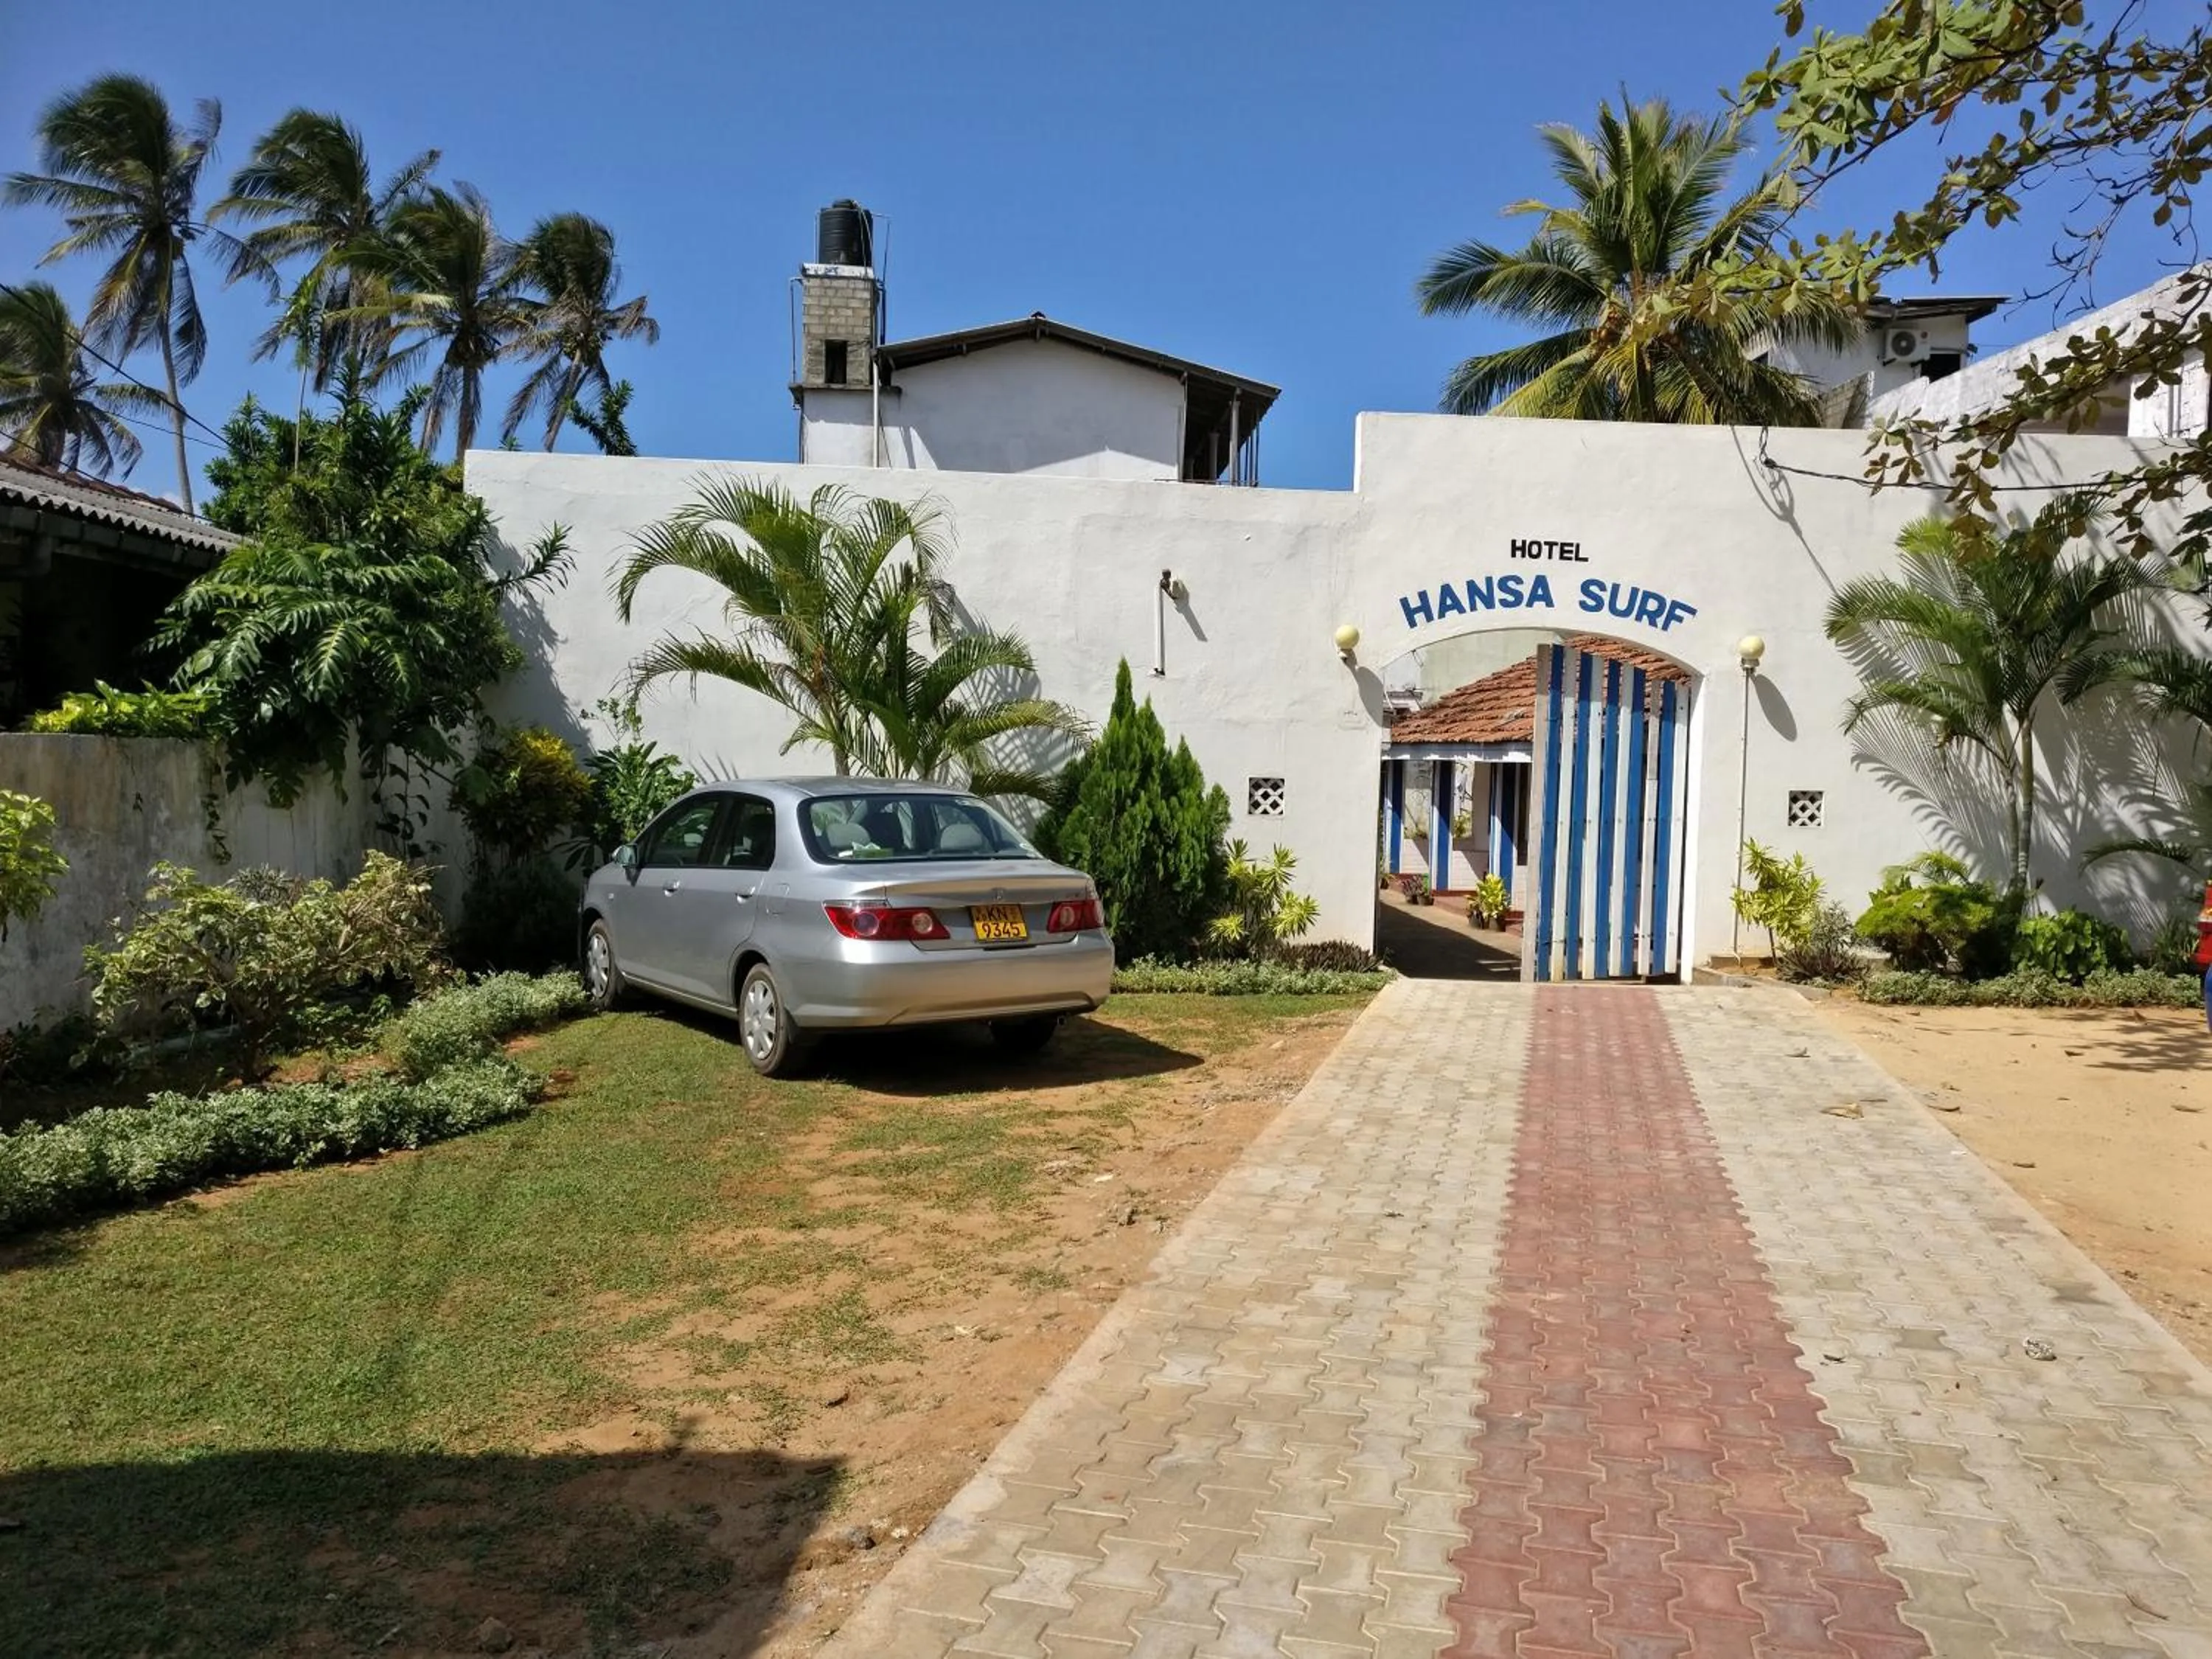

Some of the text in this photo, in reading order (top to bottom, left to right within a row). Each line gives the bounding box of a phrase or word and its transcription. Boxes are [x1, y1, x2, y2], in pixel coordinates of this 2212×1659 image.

[1511, 539, 1589, 563] HOTEL
[1399, 574, 1697, 632] HANSA SURF
[981, 922, 1020, 938] 9345
